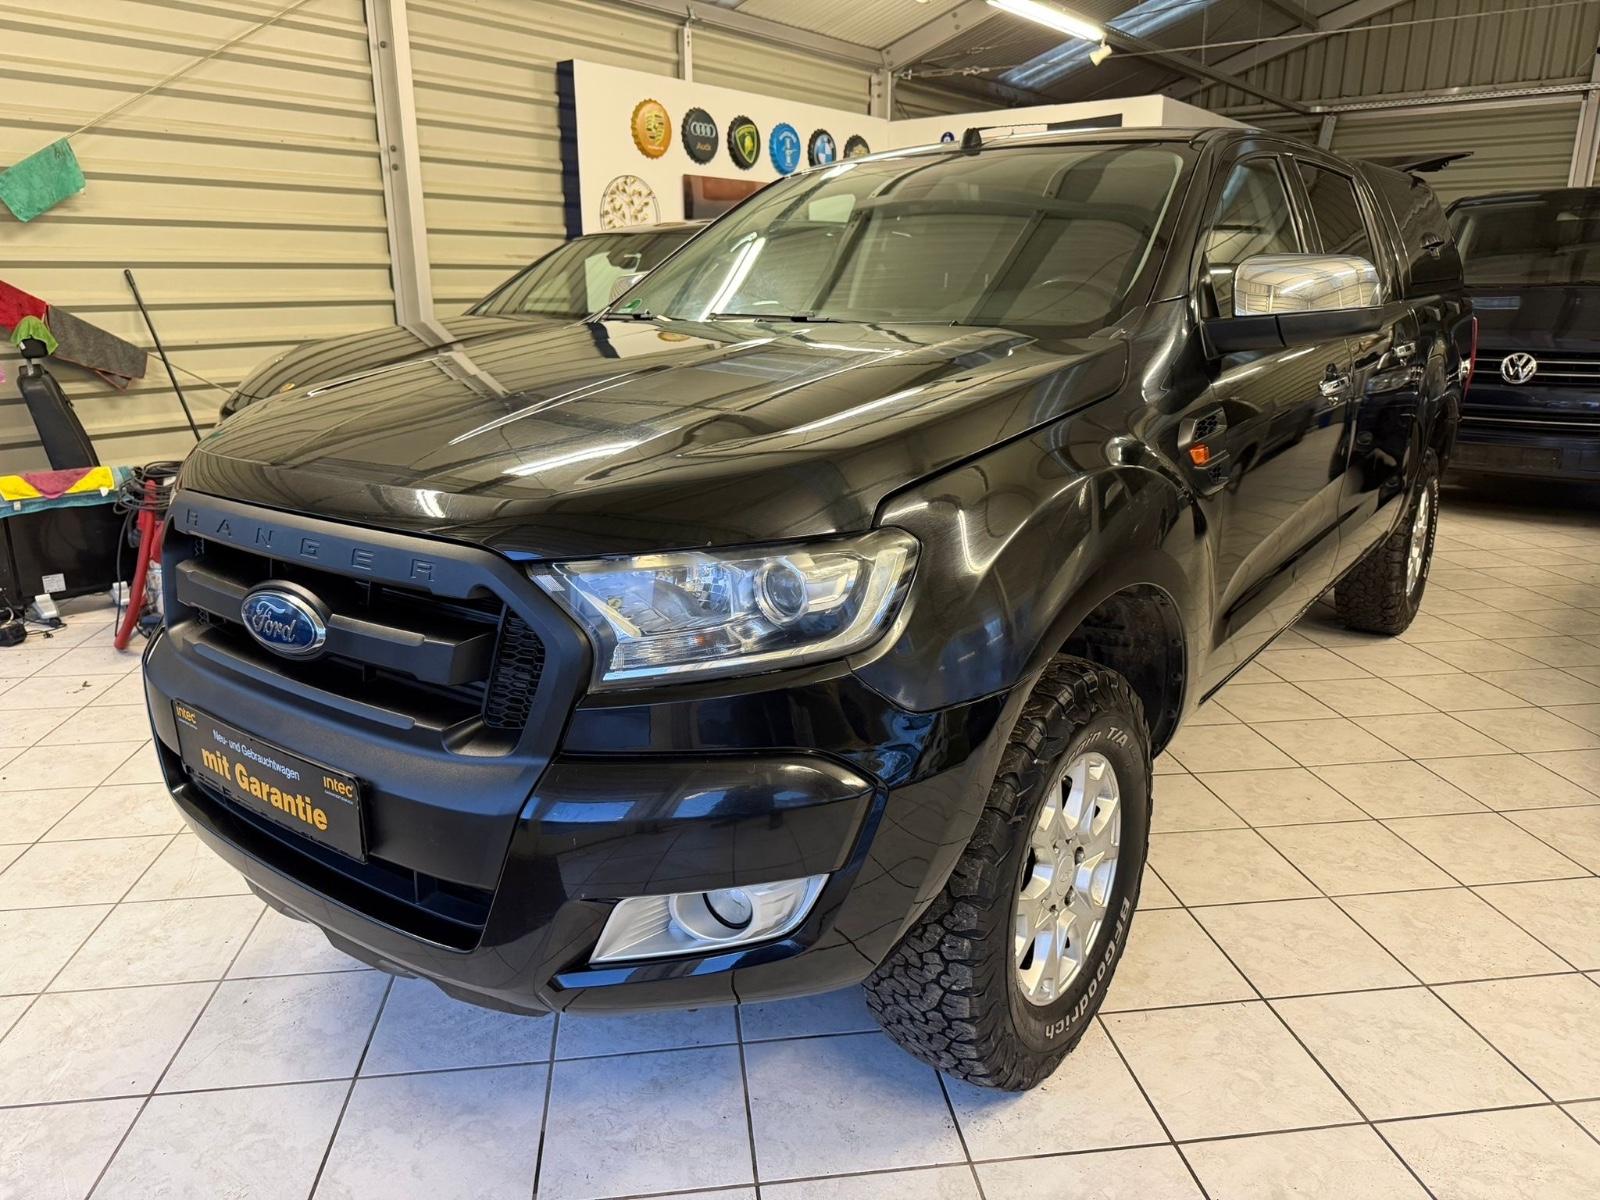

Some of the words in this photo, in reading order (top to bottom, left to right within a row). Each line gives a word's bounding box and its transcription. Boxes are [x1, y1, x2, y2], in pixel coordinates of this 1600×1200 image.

[186, 508, 437, 582] RANGER
[252, 600, 298, 643] Ford
[212, 729, 228, 746] Neu-
[229, 739, 241, 753] und
[241, 744, 300, 781] Gebrauchtwagen
[1106, 726, 1129, 748] T/A
[201, 748, 232, 781] mit
[235, 762, 328, 831] Garantie
[1045, 896, 1130, 1039] BFGoodrich
